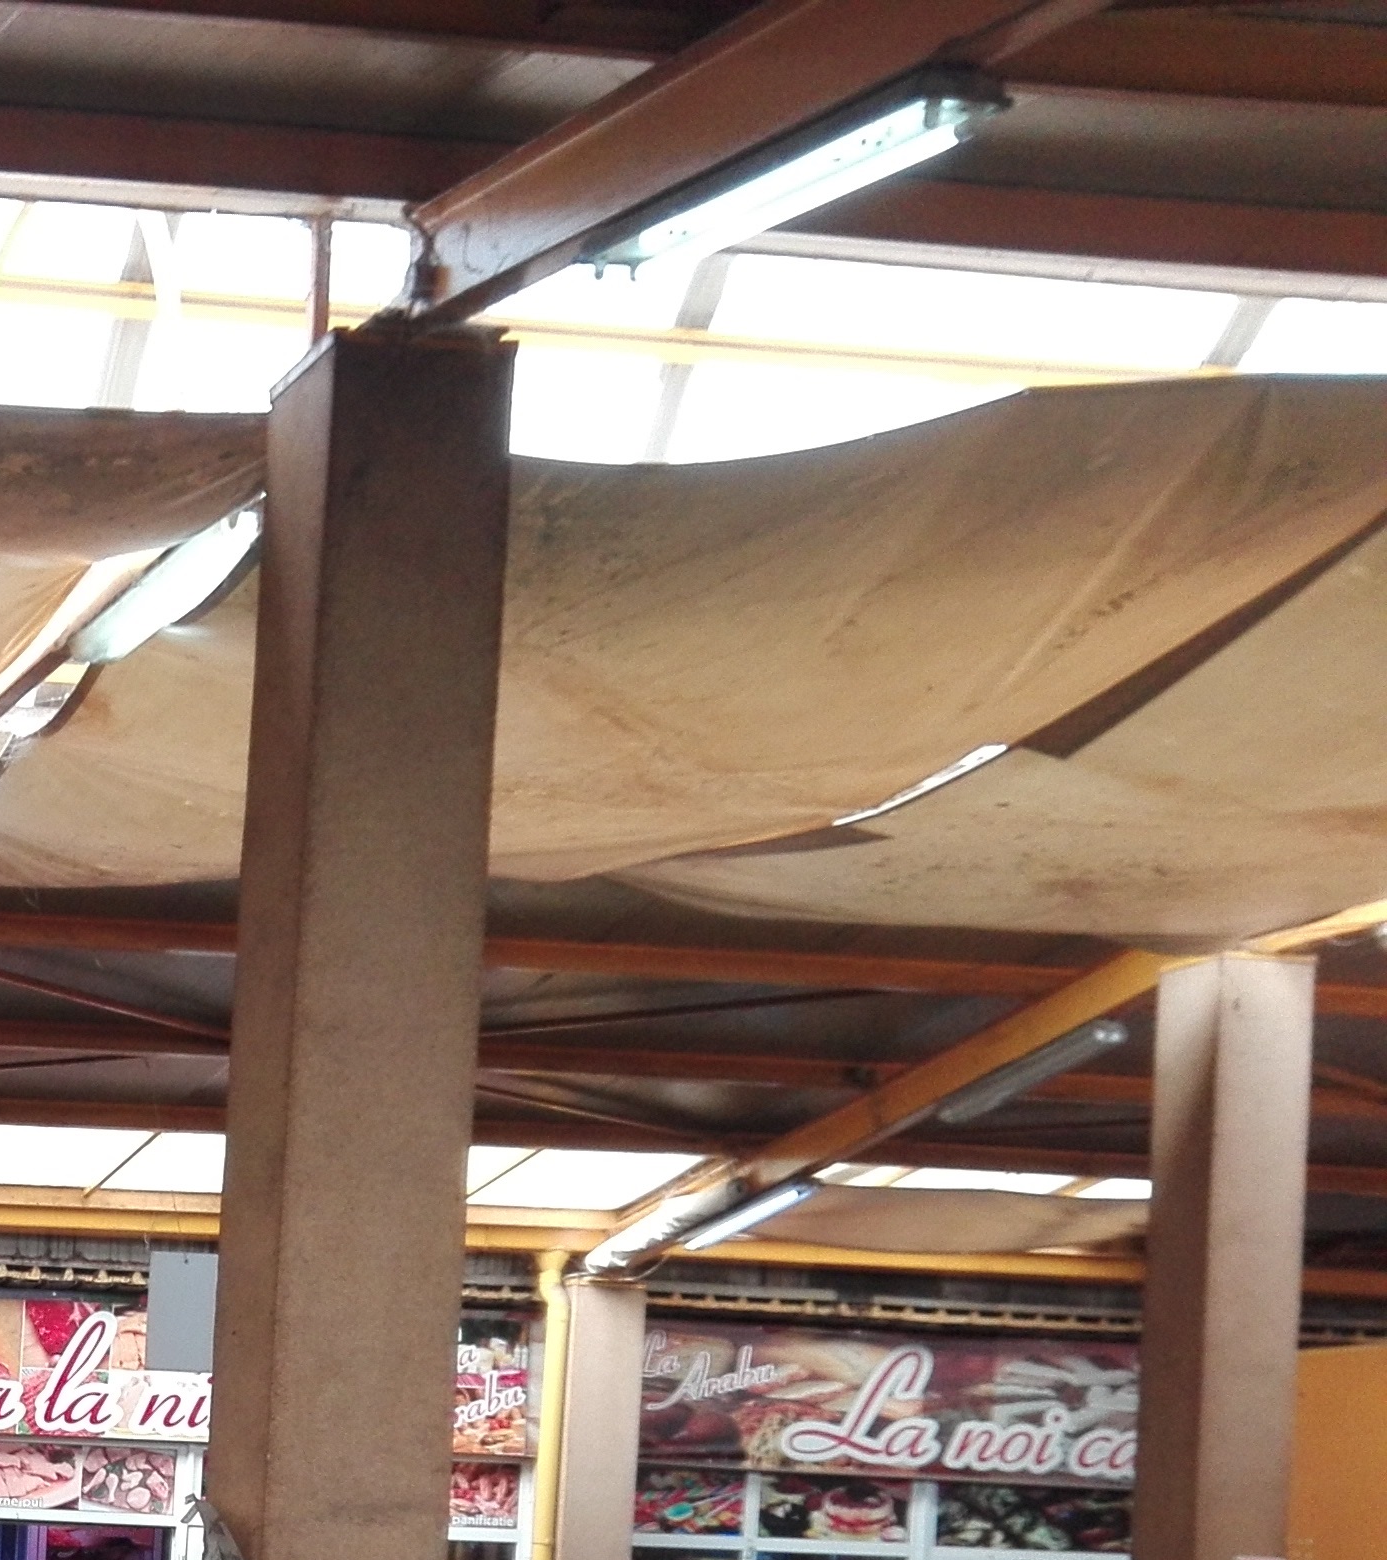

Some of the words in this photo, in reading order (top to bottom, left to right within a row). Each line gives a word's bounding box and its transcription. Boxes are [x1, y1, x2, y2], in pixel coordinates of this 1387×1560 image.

[39, 1315, 117, 1428] la
[784, 1346, 937, 1464] La
[946, 1407, 1064, 1474] noi
